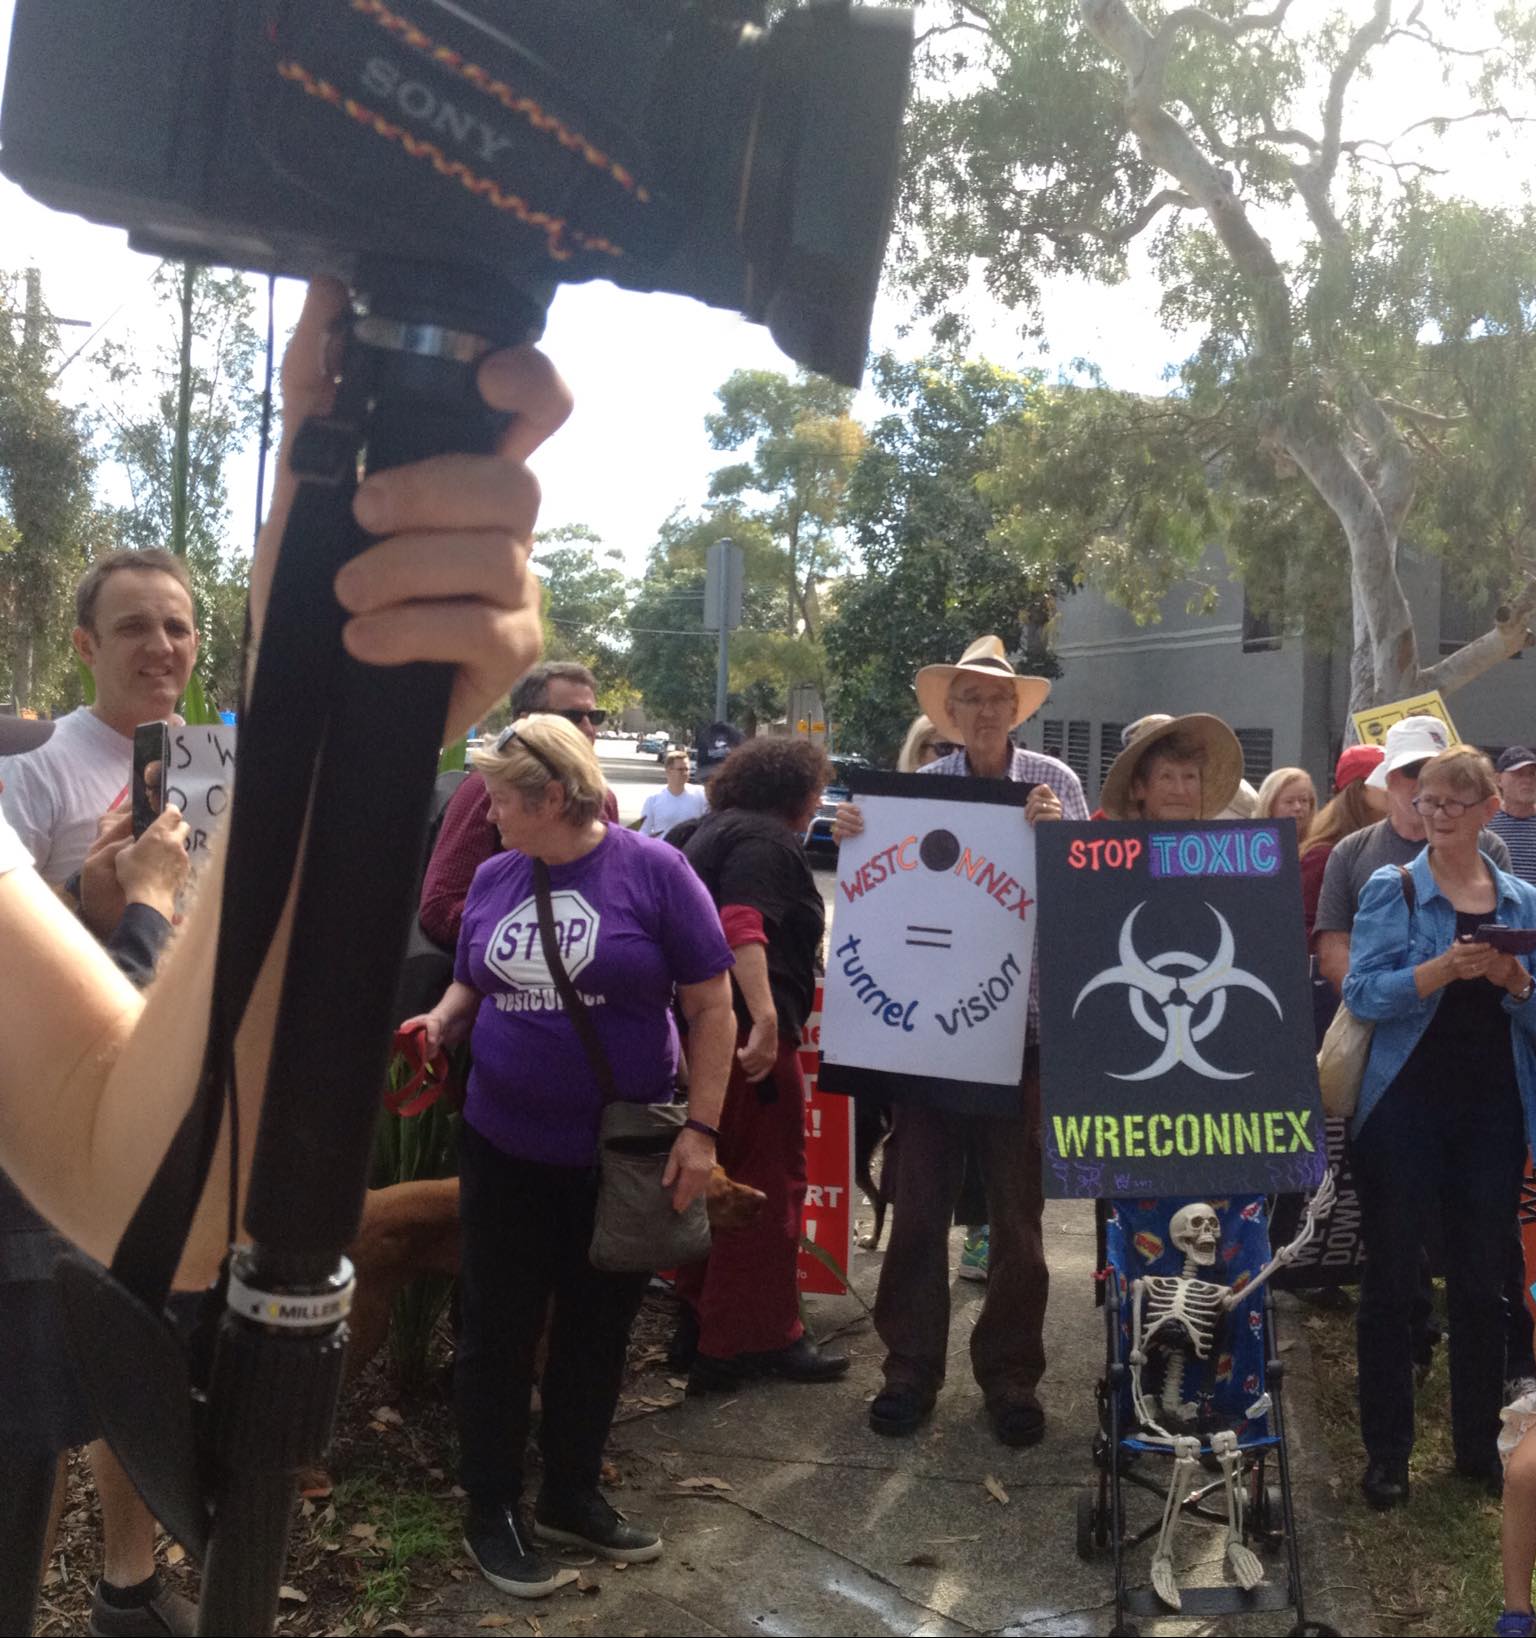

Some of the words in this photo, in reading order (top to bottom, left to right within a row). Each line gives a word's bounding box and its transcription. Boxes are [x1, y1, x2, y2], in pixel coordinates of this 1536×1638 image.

[359, 56, 513, 163] SONY
[1068, 839, 1143, 871] STOP
[1151, 831, 1278, 875] TOXIC
[836, 934, 920, 1033] tunnel
[934, 953, 1022, 1036] vision
[1052, 1109, 1316, 1157] WRECONNEX
